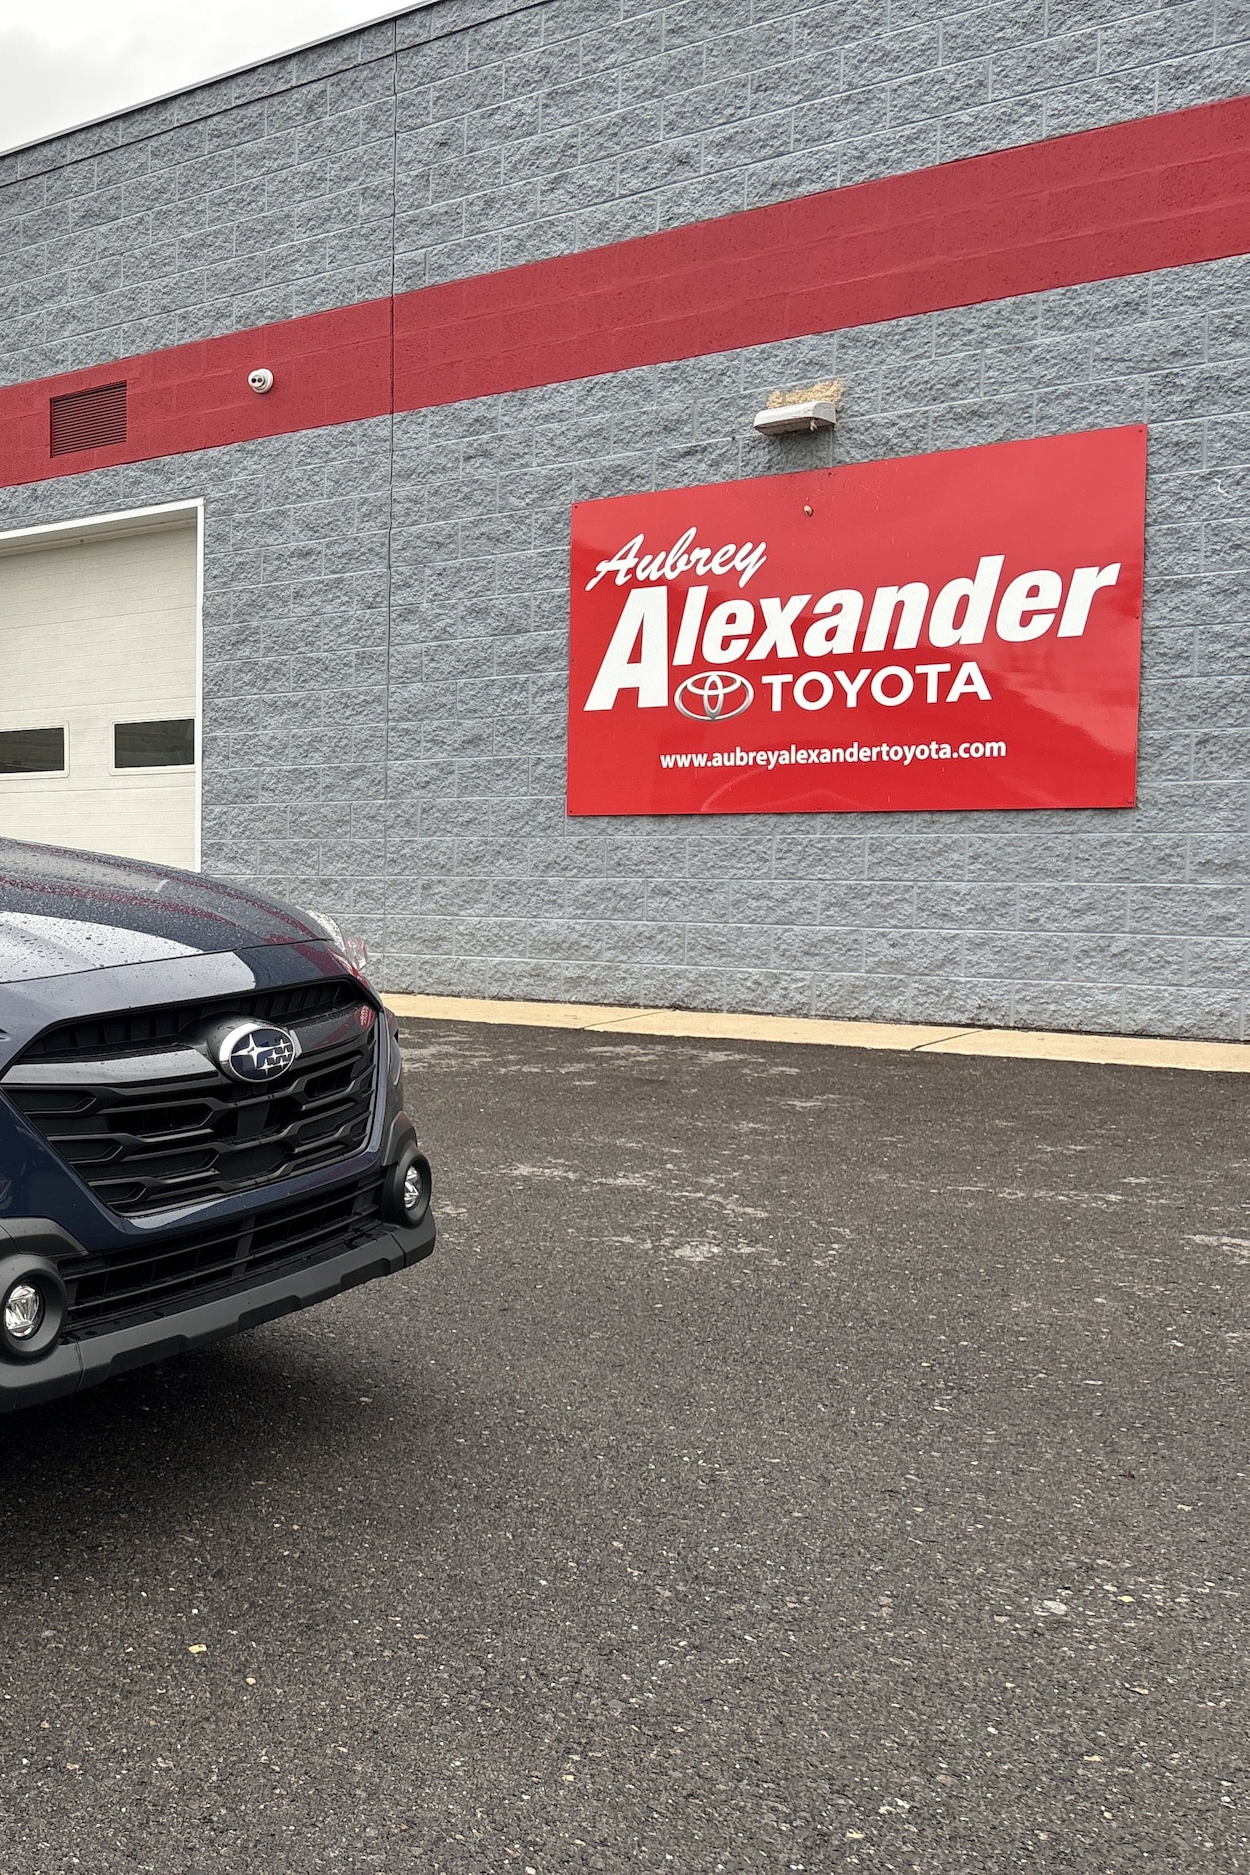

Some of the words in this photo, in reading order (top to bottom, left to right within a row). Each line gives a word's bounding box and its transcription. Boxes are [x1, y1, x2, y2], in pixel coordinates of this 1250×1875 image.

[586, 527, 766, 591] Aubrey
[584, 555, 1121, 711] Alexander
[762, 662, 991, 711] TOYOTA
[661, 741, 1006, 770] www.aubreyalexandertoyota.com
